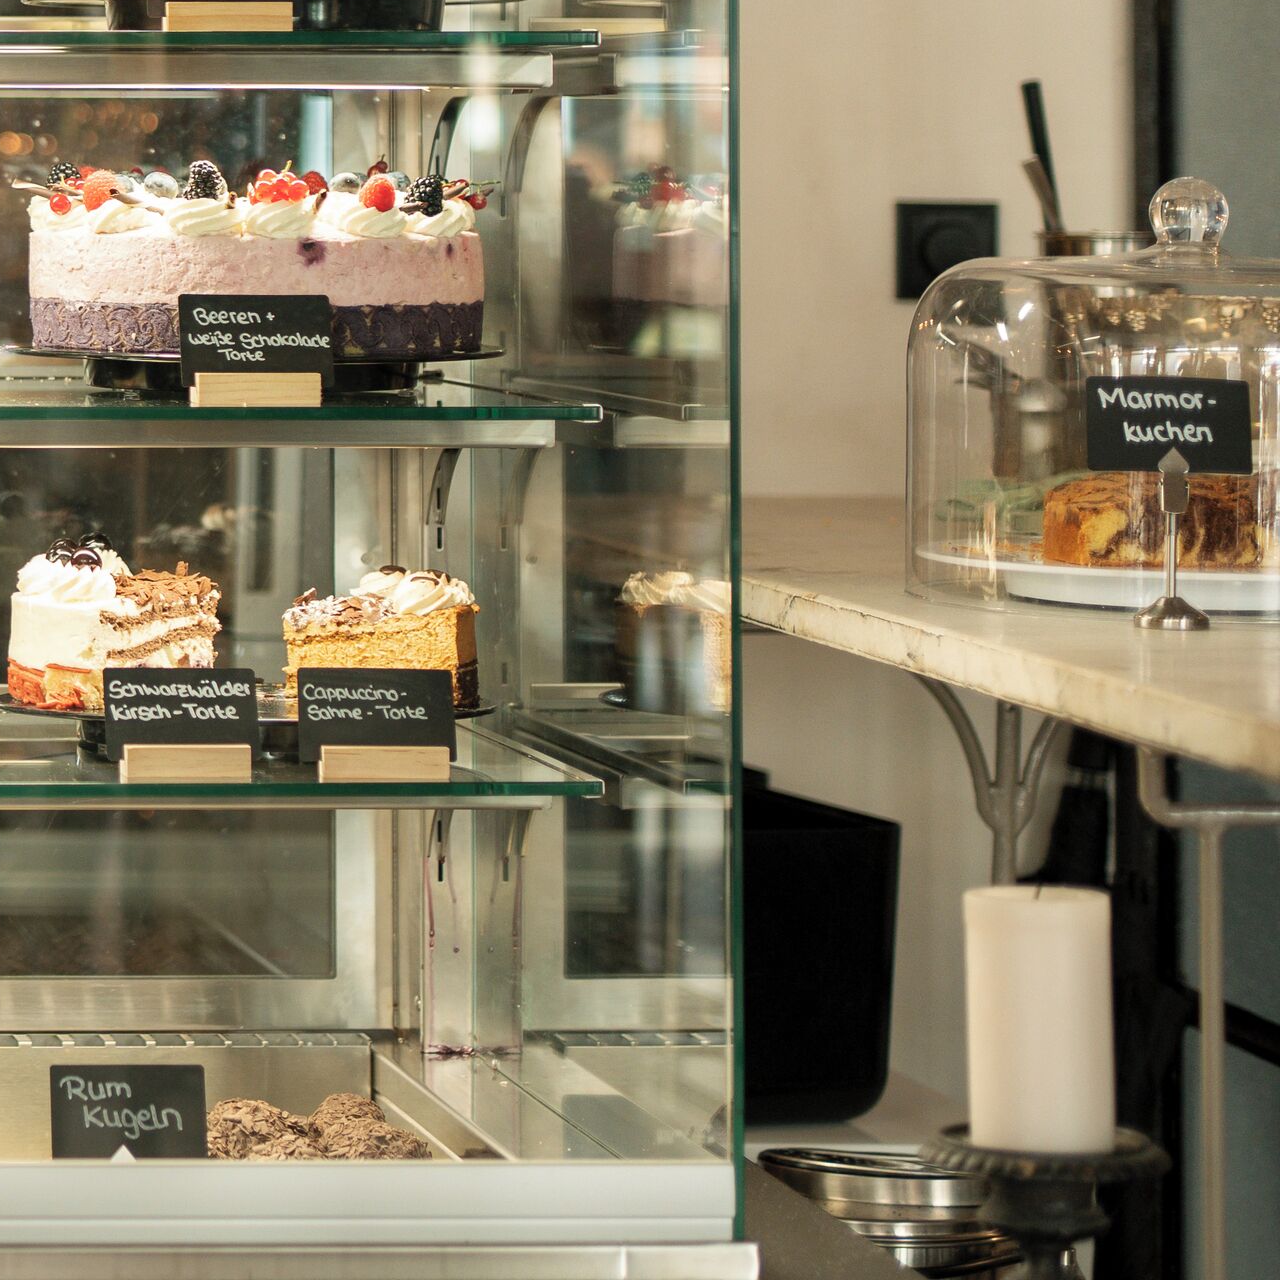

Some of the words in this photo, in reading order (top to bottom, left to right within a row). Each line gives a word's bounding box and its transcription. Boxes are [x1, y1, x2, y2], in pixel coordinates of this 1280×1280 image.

[192, 307, 262, 326] Beeren
[240, 332, 331, 350] Schokolade
[217, 348, 266, 362] Torte
[1097, 387, 1217, 410] Marmor-
[1123, 421, 1214, 443] kuchen
[109, 679, 251, 699] Schwarzwälder
[302, 683, 407, 702] Cappuccino-
[59, 1075, 132, 1101] Rum
[83, 1103, 183, 1140] Kugeln
